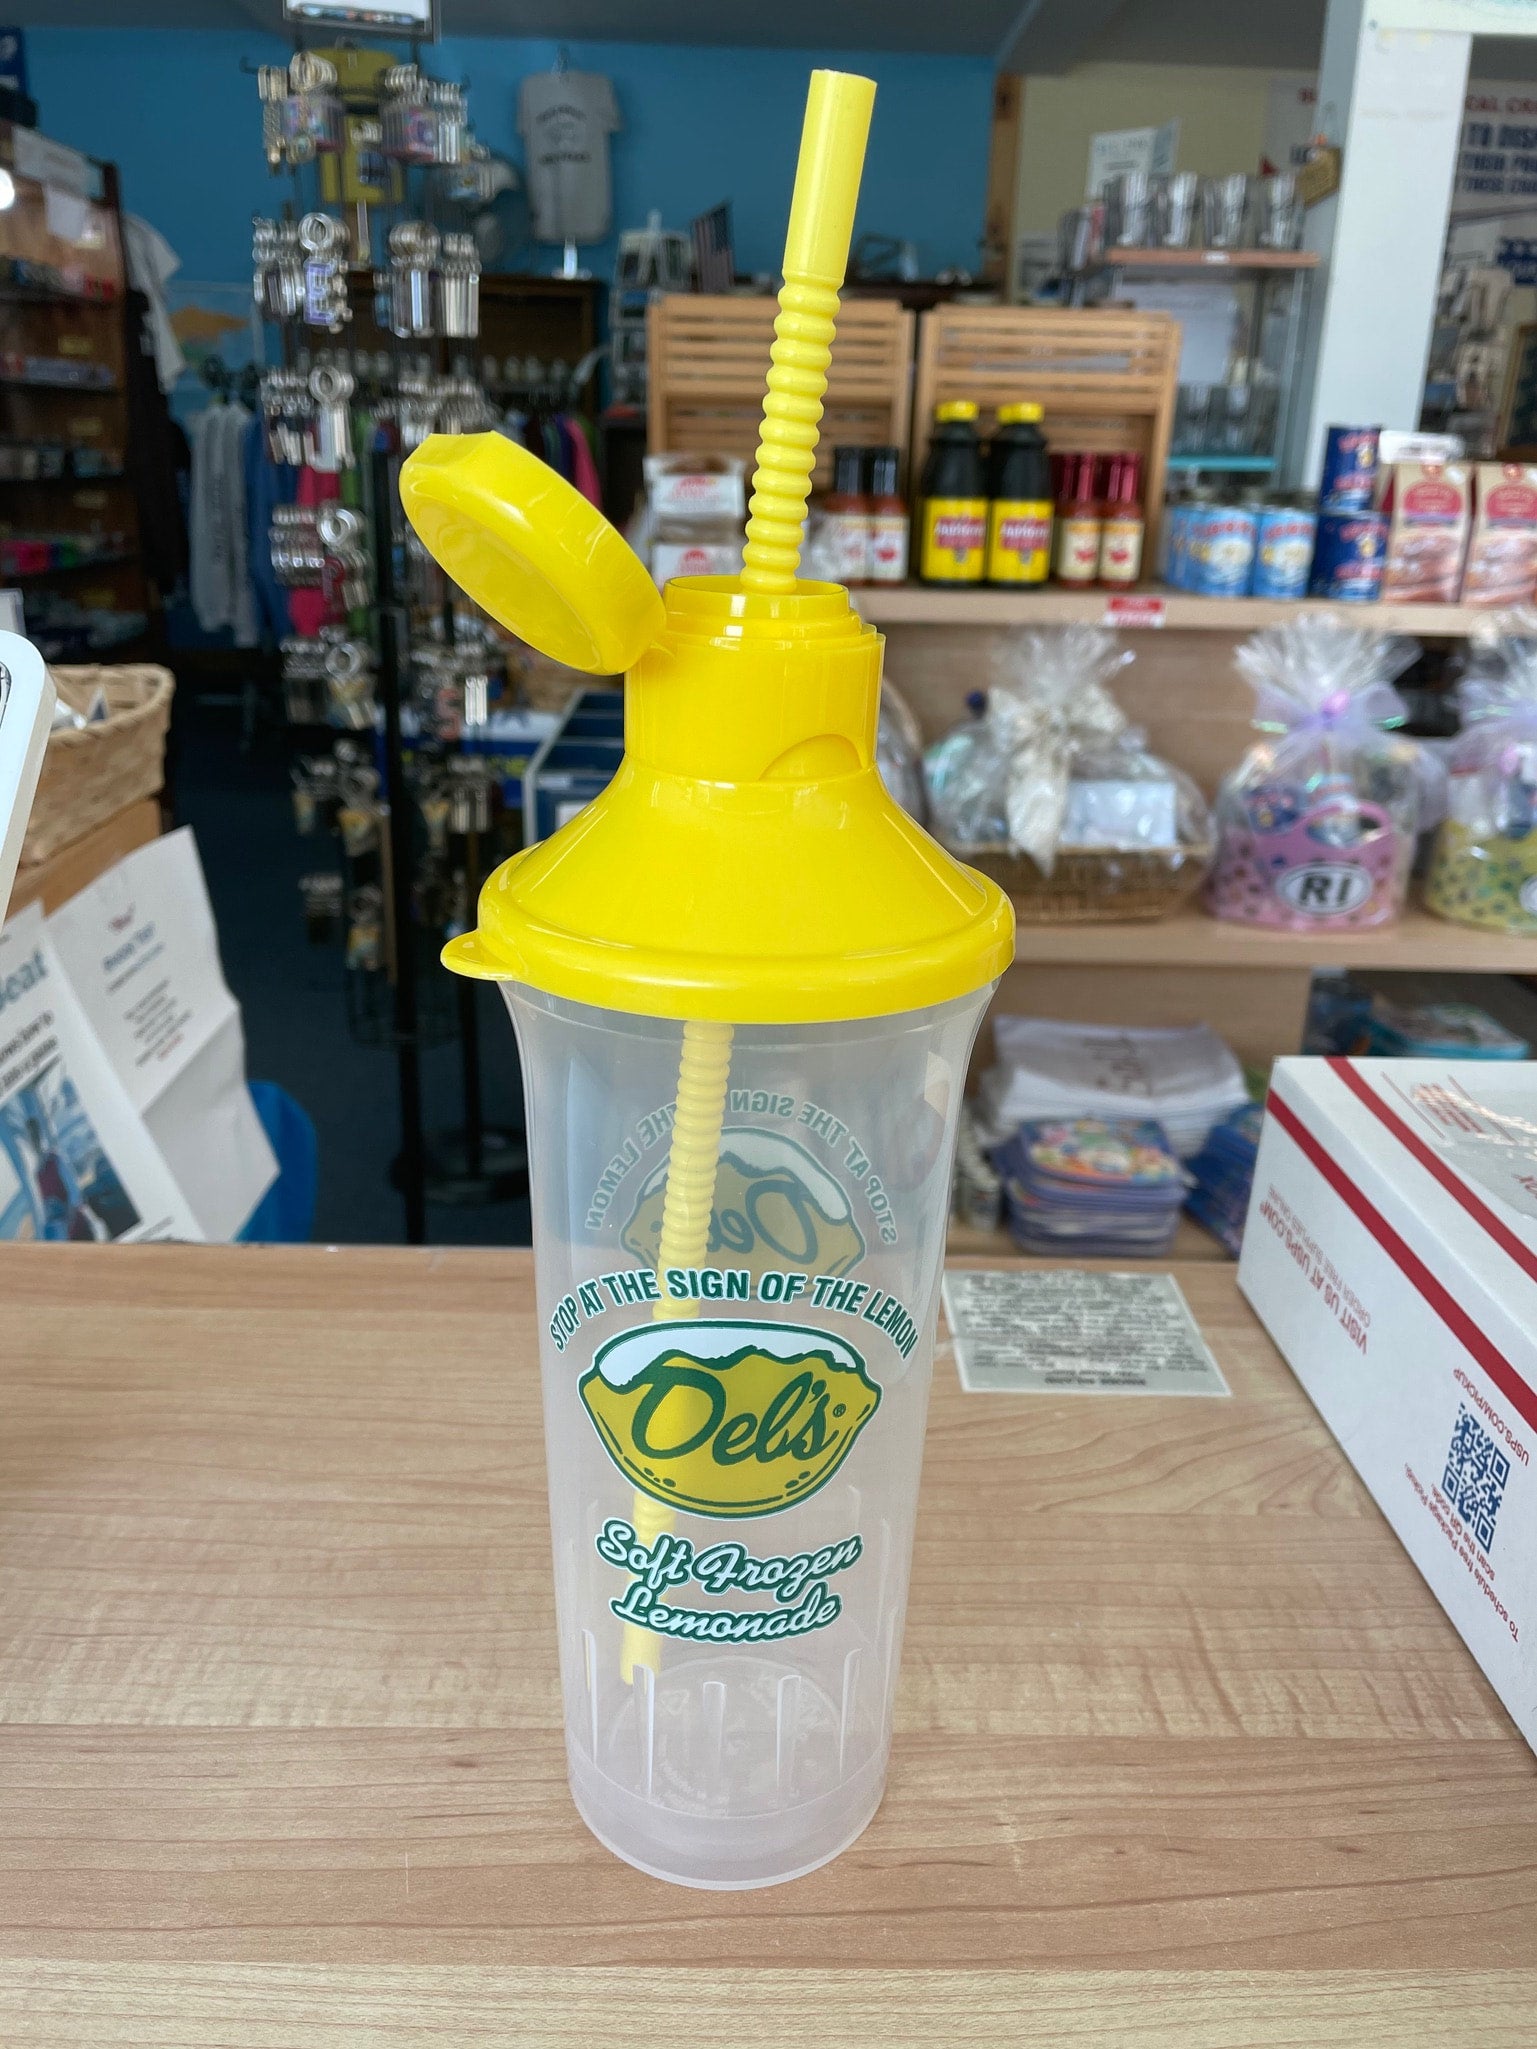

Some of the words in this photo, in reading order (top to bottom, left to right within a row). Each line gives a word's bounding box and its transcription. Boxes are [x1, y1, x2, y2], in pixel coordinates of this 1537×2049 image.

[1299, 874, 1352, 905] RI
[1310, 1267, 1325, 1290] AT
[549, 1296, 582, 1350] STOP
[580, 1282, 603, 1319] AT
[601, 1273, 660, 1305] THE
[668, 1268, 748, 1300] SIGN
[761, 1272, 806, 1304] OF
[811, 1277, 870, 1314] THE
[863, 1291, 919, 1360] LEMON
[1324, 1284, 1340, 1315] US
[1339, 1307, 1367, 1355] VISIT
[1453, 1368, 1530, 1467] USPS.COM/PICKUP
[1450, 1512, 1463, 1536] QR
[1463, 1531, 1476, 1555] the
[595, 1518, 695, 1590] Soft
[692, 1534, 864, 1604] Frozen
[1458, 1546, 1474, 1573] free
[1476, 1549, 1495, 1581] scan
[1474, 1568, 1509, 1622] schedule
[609, 1582, 842, 1645] Lemonade
[1509, 1620, 1519, 1643] To
